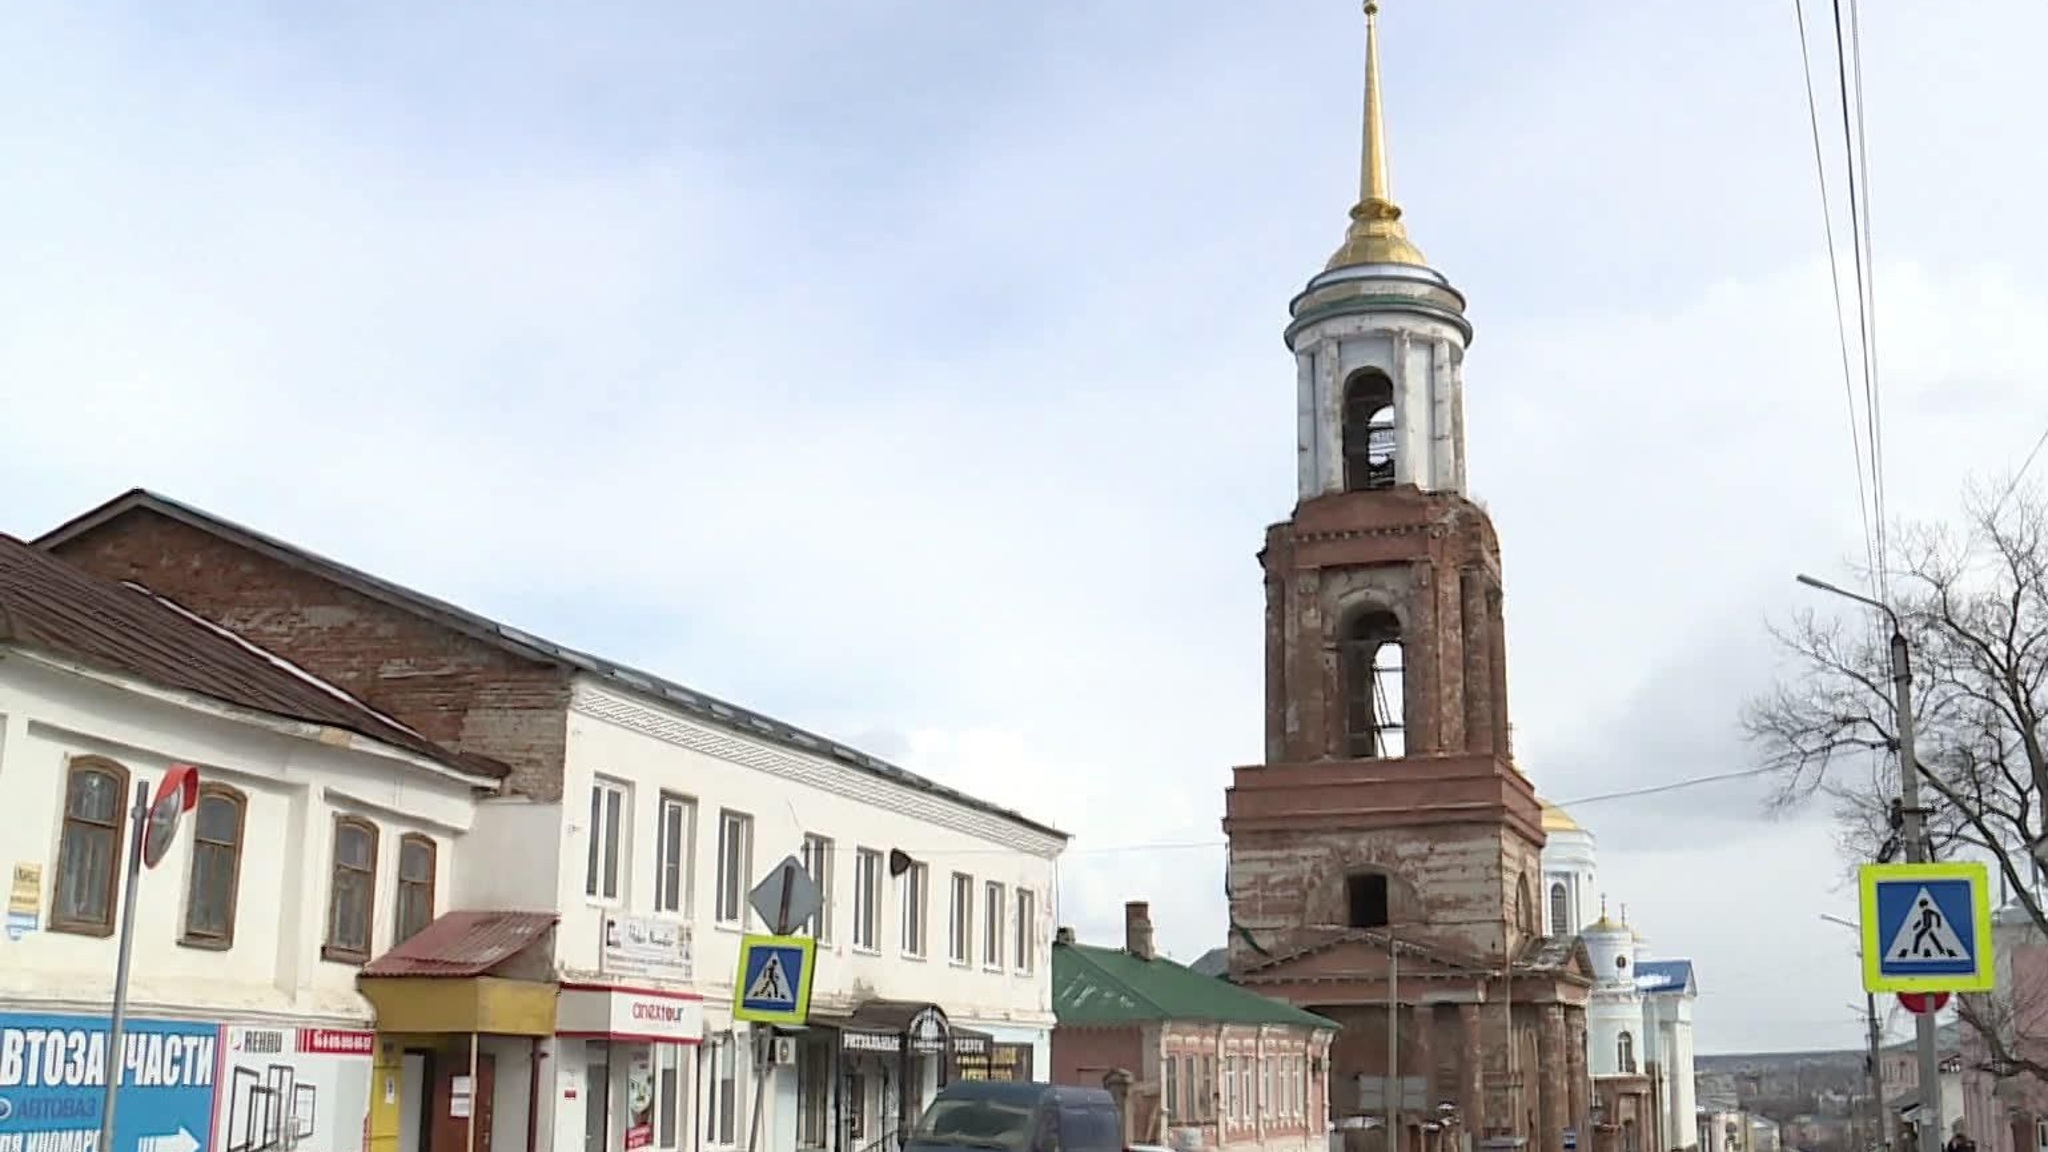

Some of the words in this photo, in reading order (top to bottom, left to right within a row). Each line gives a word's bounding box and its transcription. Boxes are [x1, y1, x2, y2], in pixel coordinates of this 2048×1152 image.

[245, 1031, 282, 1053] REHAU
[0, 1028, 214, 1087] ВТОЗАЧАСТИ
[17, 1097, 96, 1118] АВТОВАЗ
[26, 1129, 101, 1152] ИНОМАР
